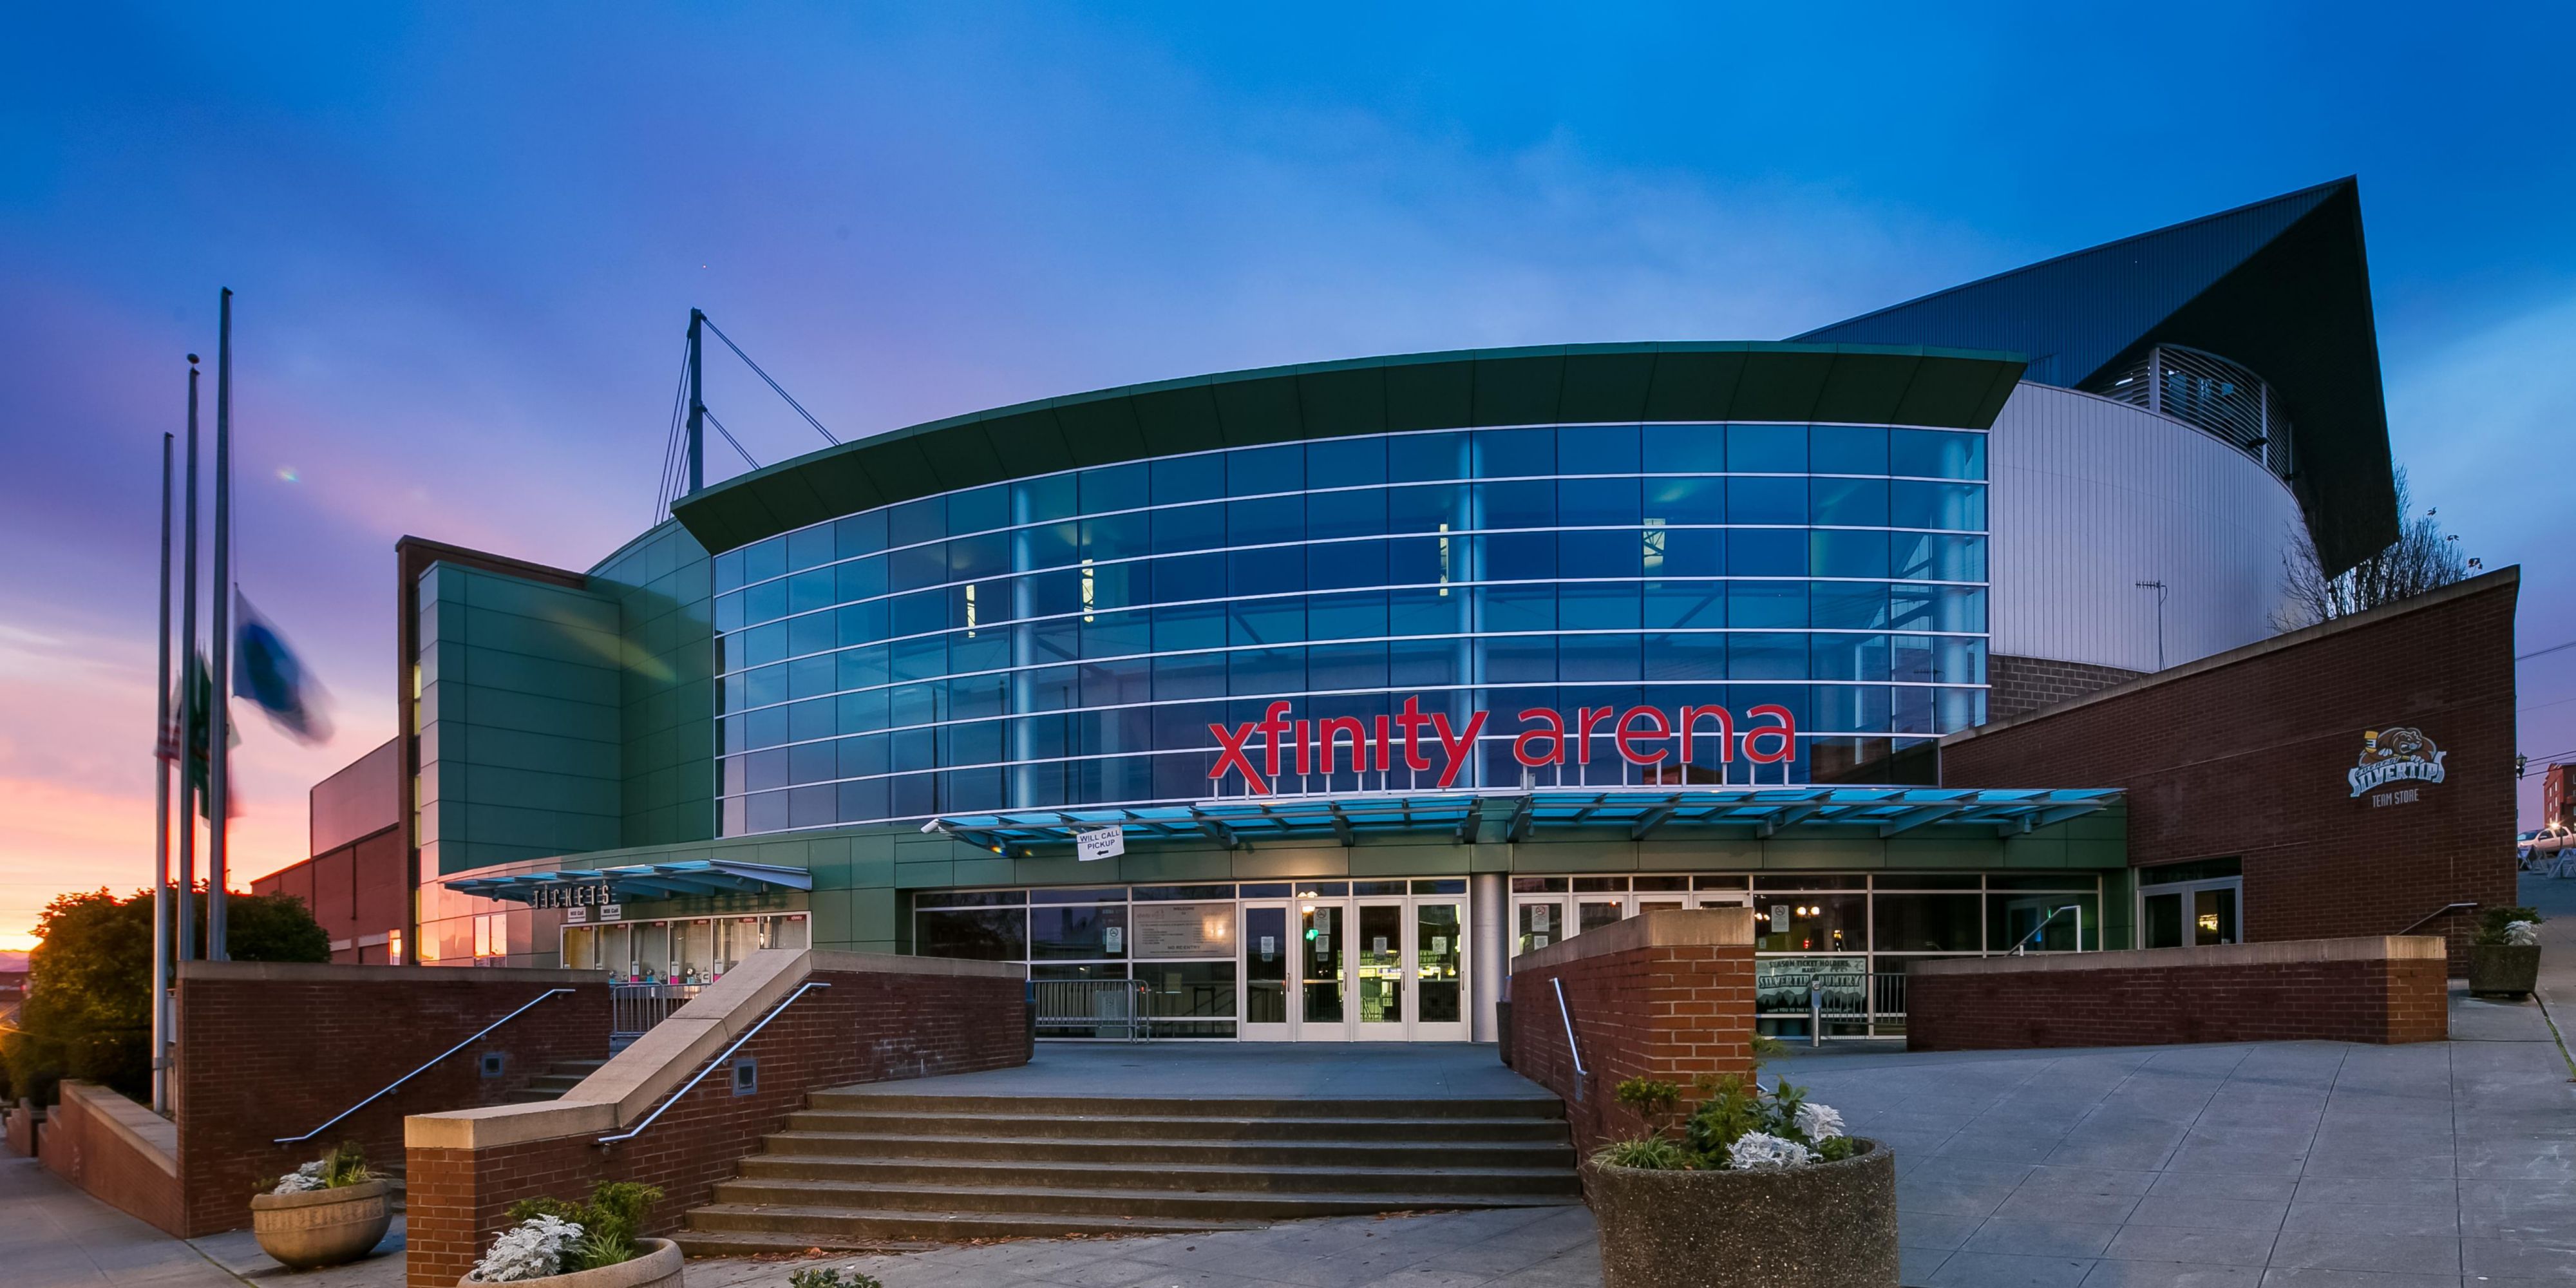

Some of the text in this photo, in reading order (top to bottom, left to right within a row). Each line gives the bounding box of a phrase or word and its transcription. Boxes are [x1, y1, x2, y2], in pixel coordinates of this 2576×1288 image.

[1208, 695, 1795, 795] xfinity arena
[2348, 751, 2447, 797] SILVERTIPS
[2372, 789, 2419, 808] TEAM STORE
[1088, 839, 1115, 849] PICKUP
[1101, 830, 1119, 839] CALL
[534, 885, 609, 909] TICKETS
[1759, 974, 1861, 989] SILVERTIP OUNTRY
